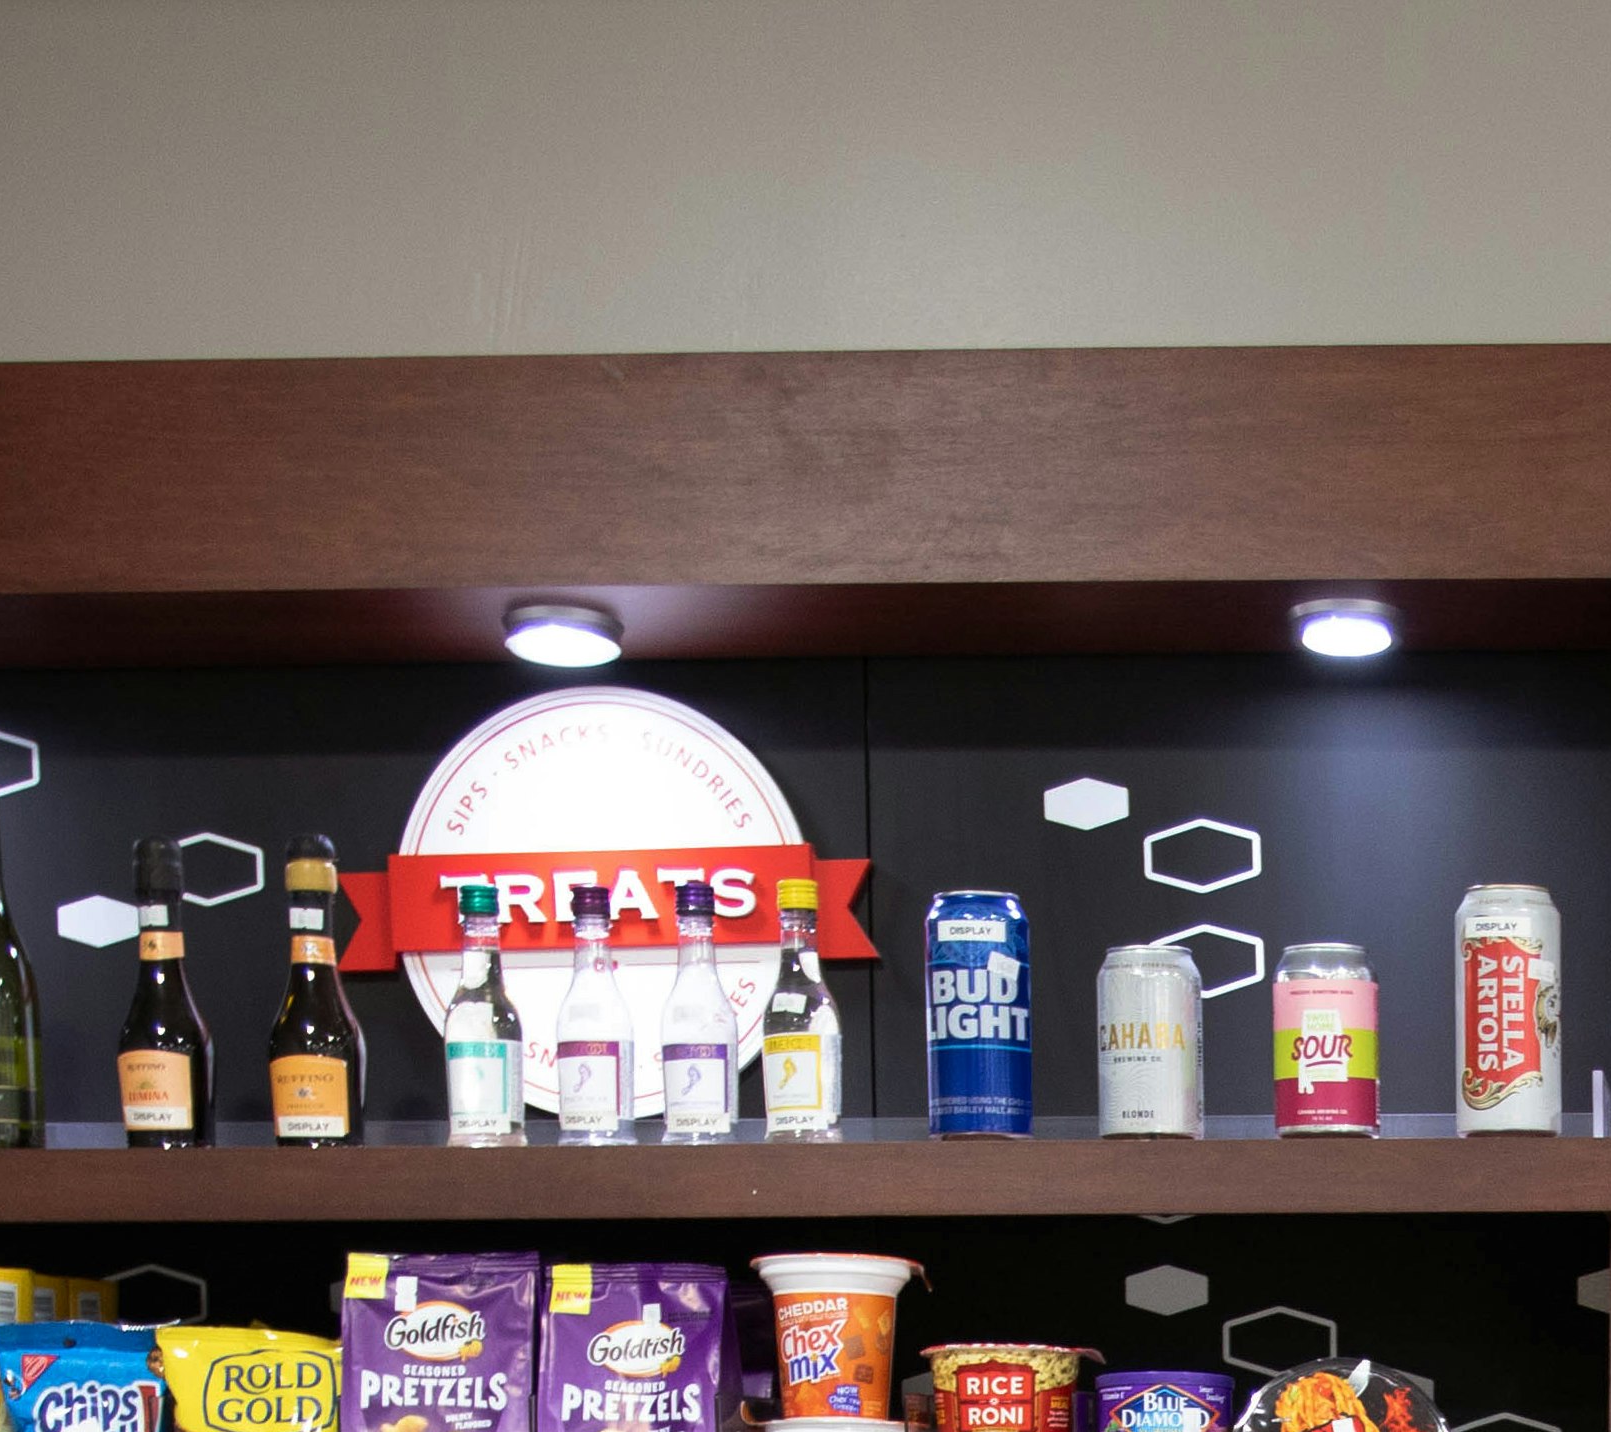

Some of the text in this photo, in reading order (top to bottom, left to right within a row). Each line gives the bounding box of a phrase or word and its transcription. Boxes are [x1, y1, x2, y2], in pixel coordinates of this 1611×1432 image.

[447, 724, 752, 835] SIPS SNACKS SUNDRIES
[949, 926, 991, 936] DISPLAY
[1476, 922, 1517, 931] DISPLAY
[932, 970, 1018, 1004] BUD
[927, 1004, 1029, 1041] LIGHT
[1477, 955, 1499, 1071] ARTOIS
[1501, 955, 1526, 1070] STELLA
[1122, 1109, 1155, 1119] BLONDE
[778, 1298, 848, 1320] CHEDDAR
[385, 1311, 485, 1350] Goldfish
[224, 1362, 322, 1394] ROLD
[403, 1365, 466, 1376] SEASONED
[966, 1376, 1024, 1395] RICE
[360, 1370, 507, 1411] PRETZELS
[561, 1383, 701, 1422] PRETZELS
[1143, 1393, 1189, 1412] BLUE
[218, 1396, 322, 1424] GOLD
[968, 1405, 1024, 1425] RONI
